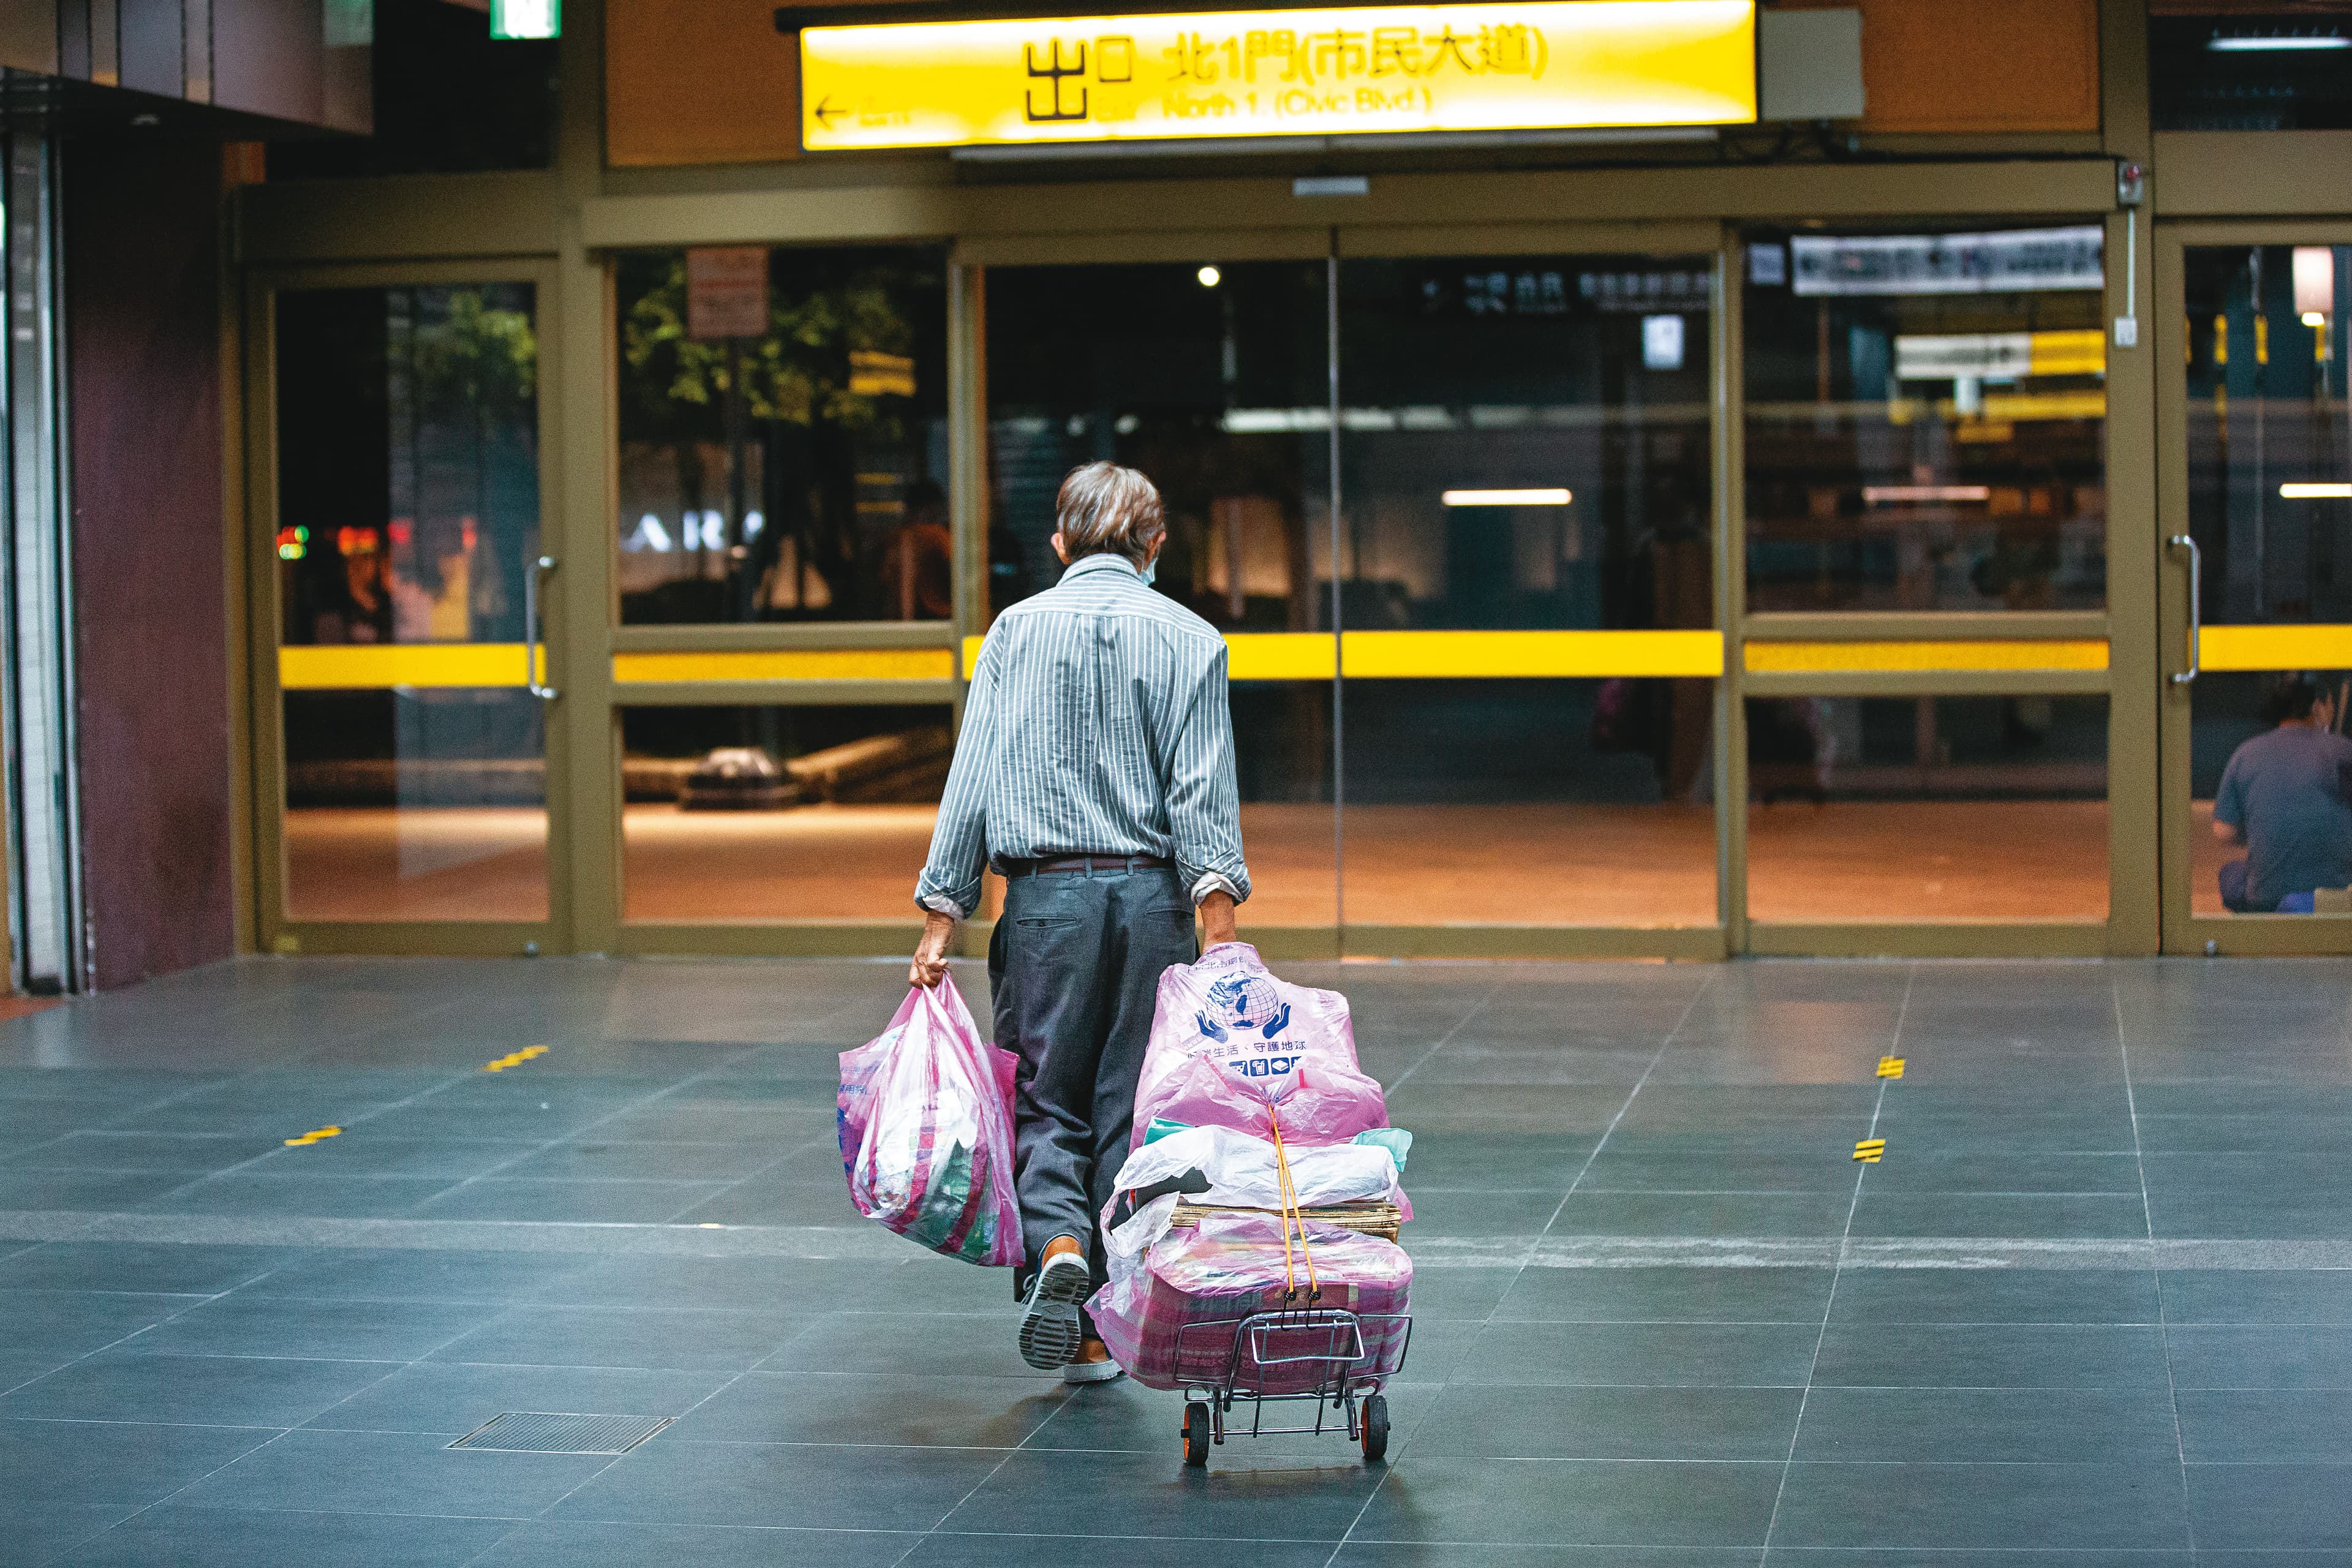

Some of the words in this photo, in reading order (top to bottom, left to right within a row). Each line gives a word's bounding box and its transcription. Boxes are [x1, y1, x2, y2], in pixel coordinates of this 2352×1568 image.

[1023, 37, 1133, 123] 出口
[1163, 23, 1548, 86] 北1門(市民大道)
[1163, 91, 1236, 118] North
[1275, 88, 1348, 119] (Civic
